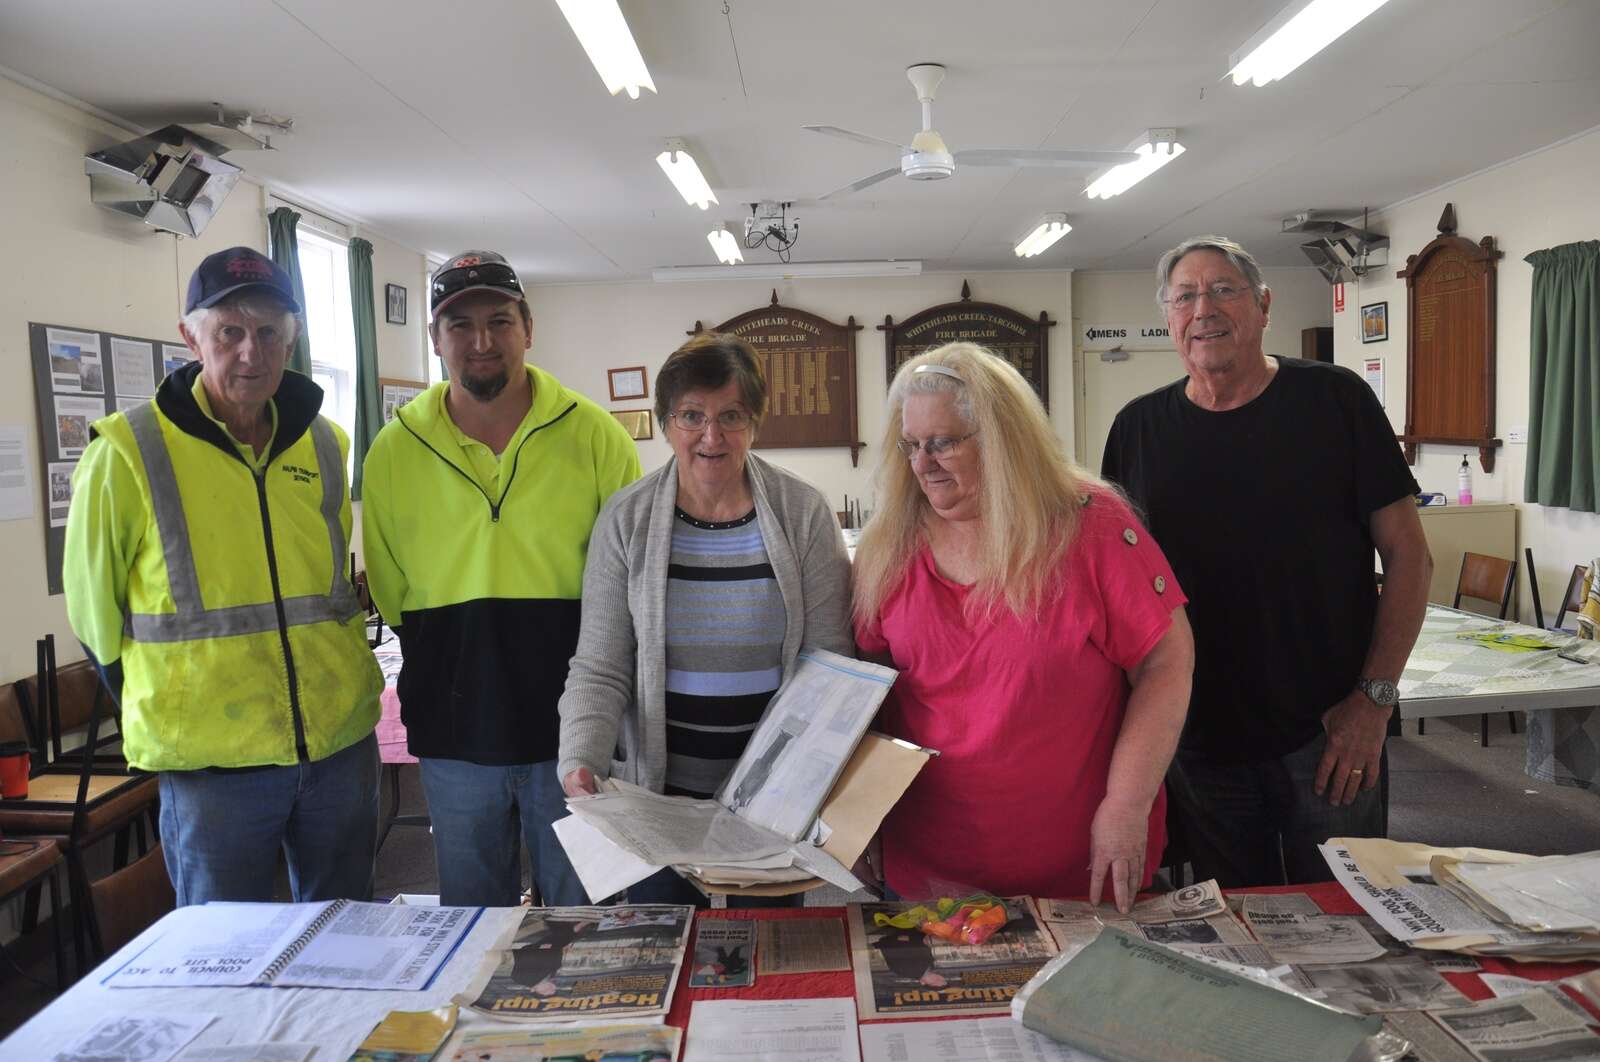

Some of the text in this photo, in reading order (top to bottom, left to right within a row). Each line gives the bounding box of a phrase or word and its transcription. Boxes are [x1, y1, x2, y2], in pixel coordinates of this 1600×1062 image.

[735, 317, 824, 336] HITEHEADS CREEK
[904, 314, 958, 338] WHITEHEADS
[767, 334, 807, 343] BRIGADE
[935, 329, 998, 339] FIRE BRIGADE
[1097, 328, 1127, 338] MENS
[1336, 849, 1351, 859] IN
[1343, 862, 1360, 873] BE
[1379, 899, 1404, 915] POOL
[1398, 917, 1425, 933] WHY
[187, 965, 242, 974] COUNCIL
[492, 992, 659, 1010] Heating up!
[894, 987, 1016, 1005] ating up!
